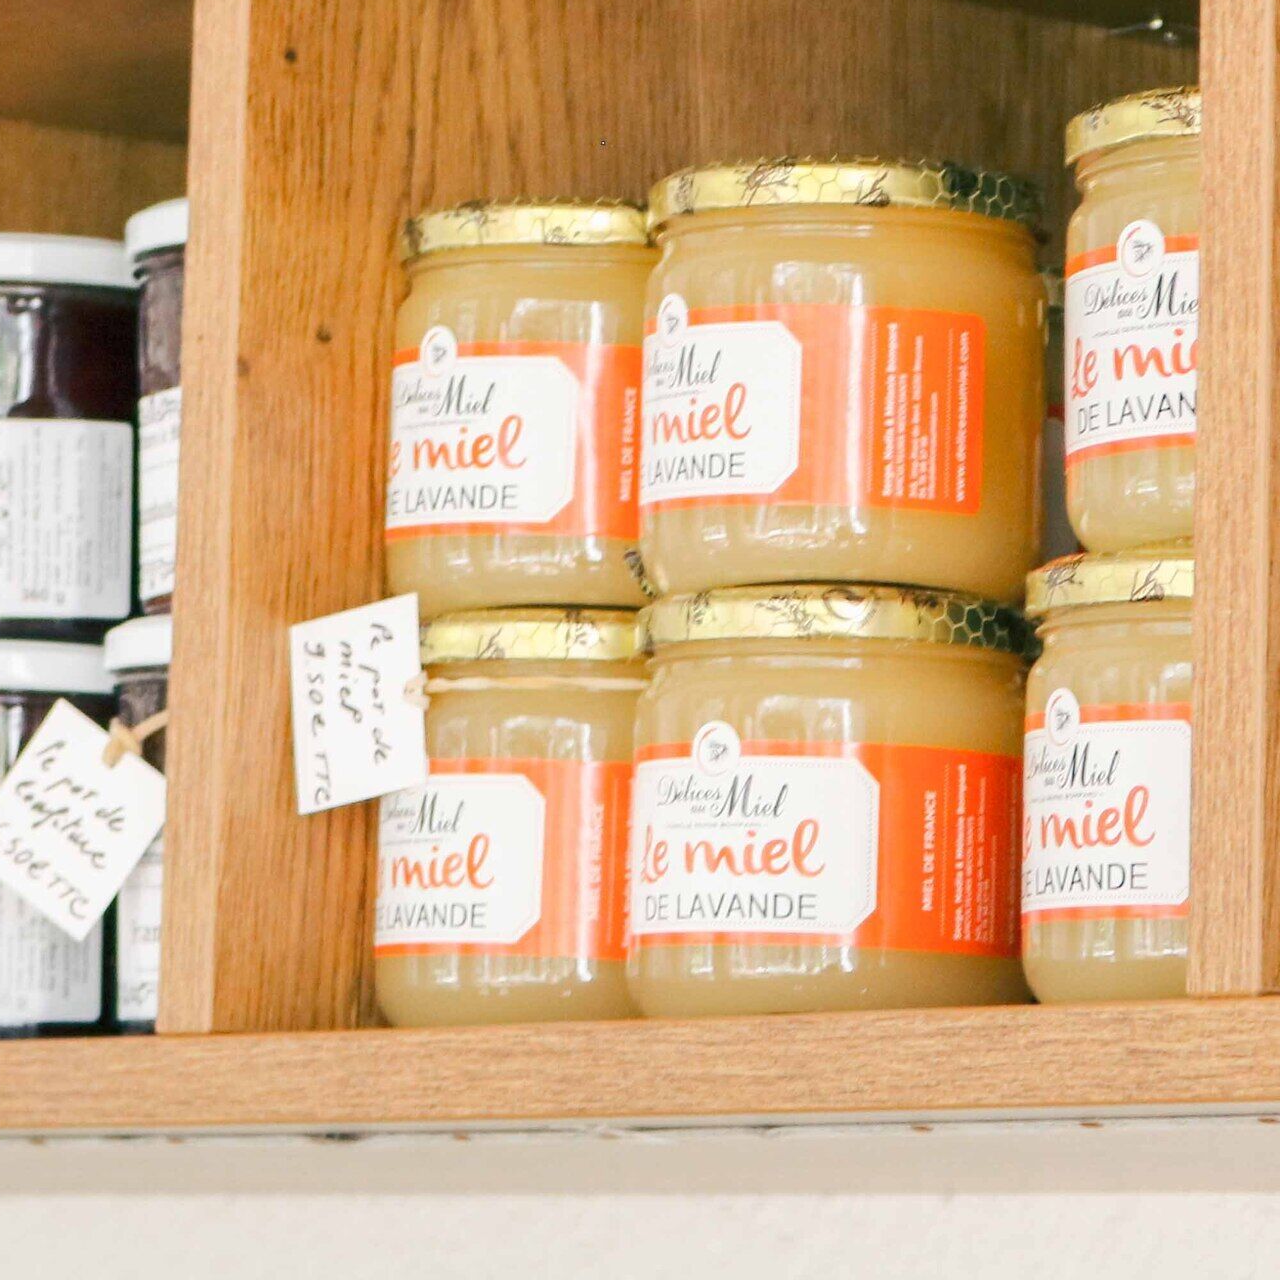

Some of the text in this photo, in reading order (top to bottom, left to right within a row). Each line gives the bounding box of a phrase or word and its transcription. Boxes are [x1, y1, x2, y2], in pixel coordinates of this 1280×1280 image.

[1084, 277, 1148, 317] Délices
[434, 373, 496, 417] Miel
[653, 381, 752, 446] miel
[1079, 403, 1100, 435] DE
[413, 413, 528, 472] miel
[405, 484, 519, 516] LAVANDE
[1060, 741, 1120, 789] Miel
[409, 791, 466, 834] Miel
[656, 774, 722, 807] Délices
[710, 773, 789, 819] Miel
[1041, 785, 1156, 850] miel
[923, 790, 936, 849] FRANCE
[392, 832, 495, 890] miel
[684, 818, 826, 878] miel
[923, 852, 934, 873] DE
[1035, 862, 1149, 896] LAVANDE
[645, 892, 819, 921] DE LAVANDE
